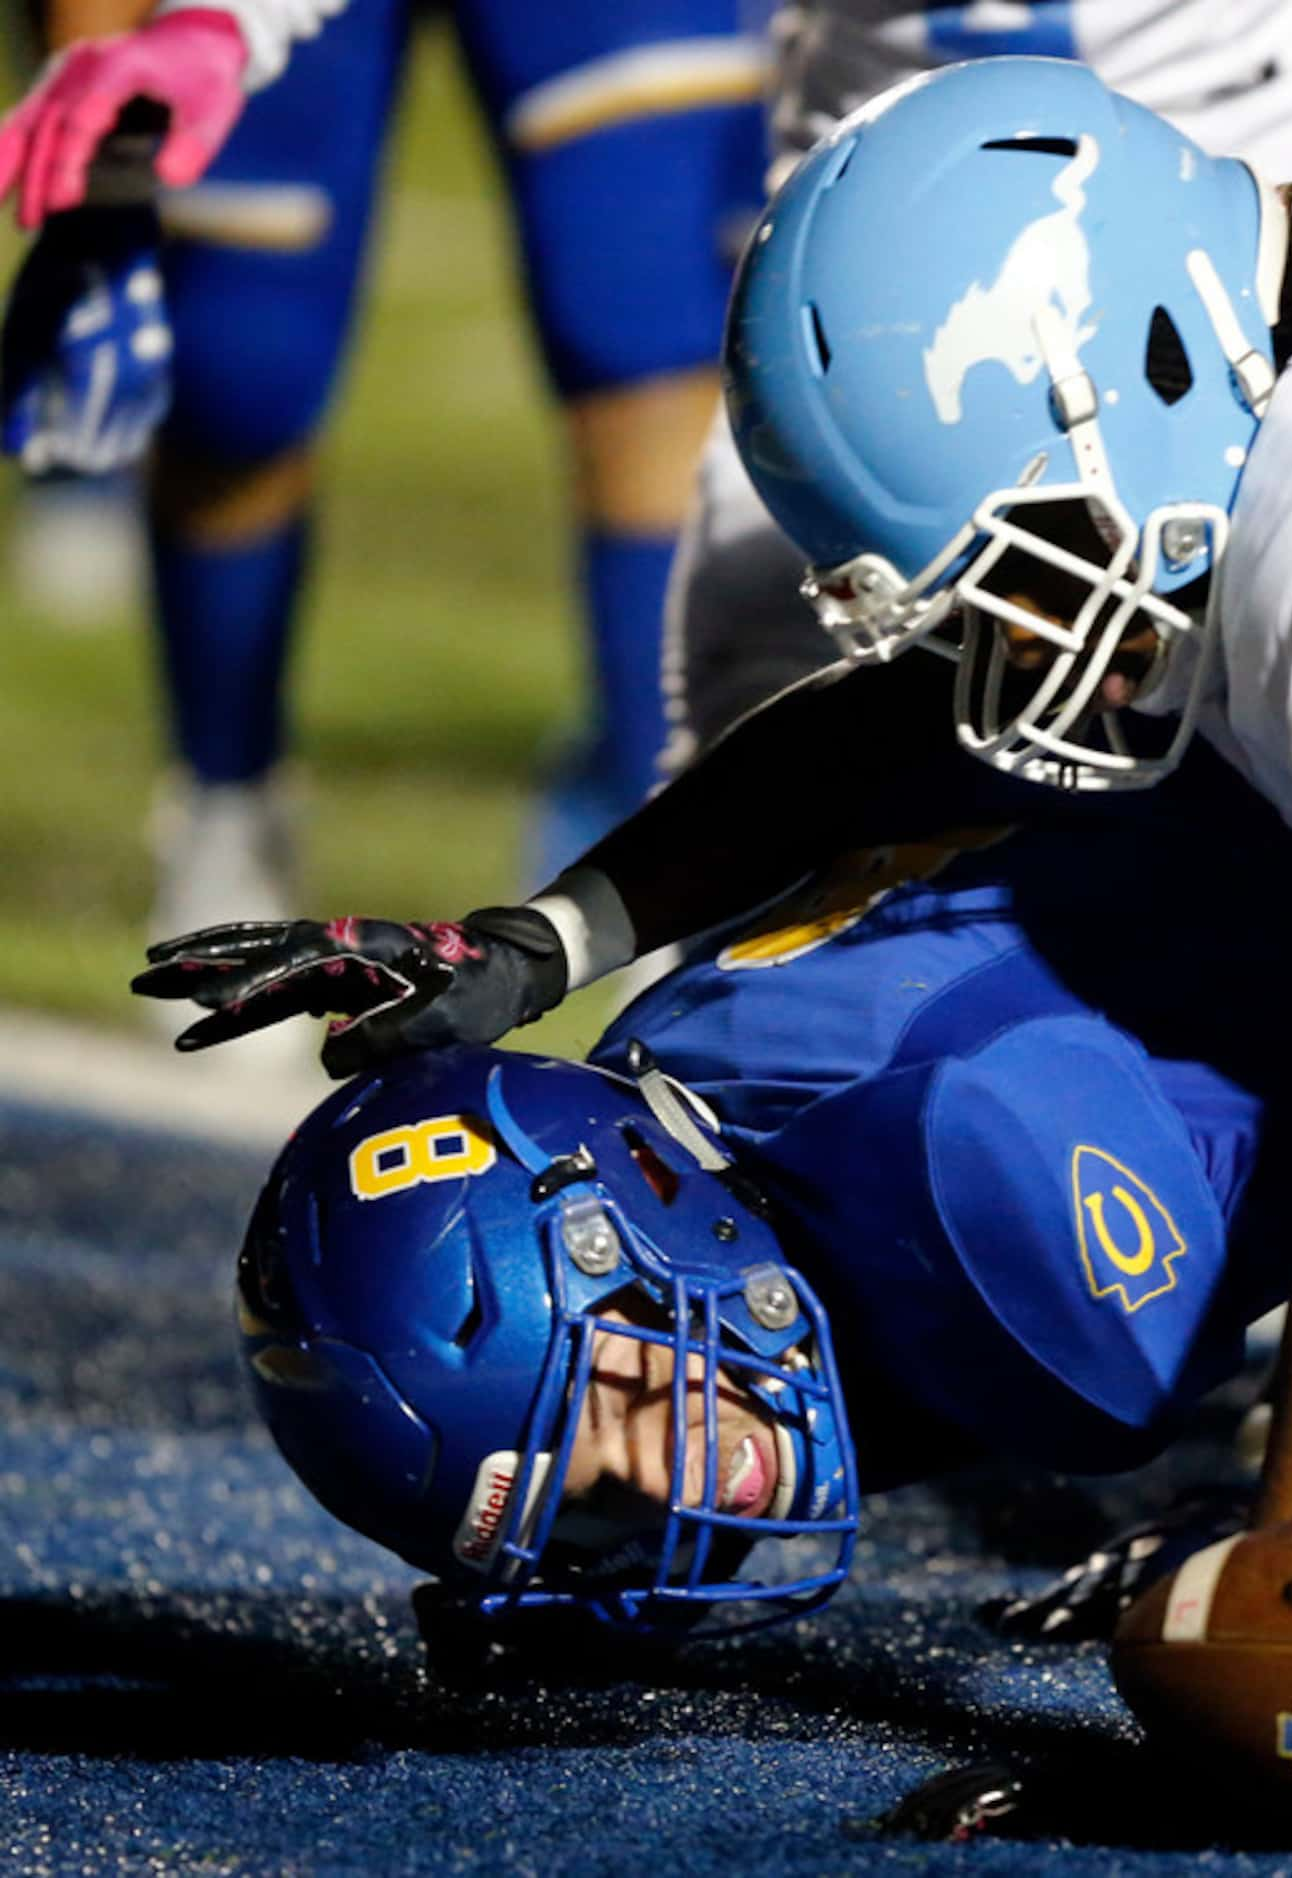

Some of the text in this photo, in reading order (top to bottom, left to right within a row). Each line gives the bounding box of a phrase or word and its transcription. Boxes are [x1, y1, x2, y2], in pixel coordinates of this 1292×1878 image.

[349, 1114, 497, 1201] 8
[1083, 1185, 1155, 1276] C
[461, 1471, 515, 1560] Riddell
